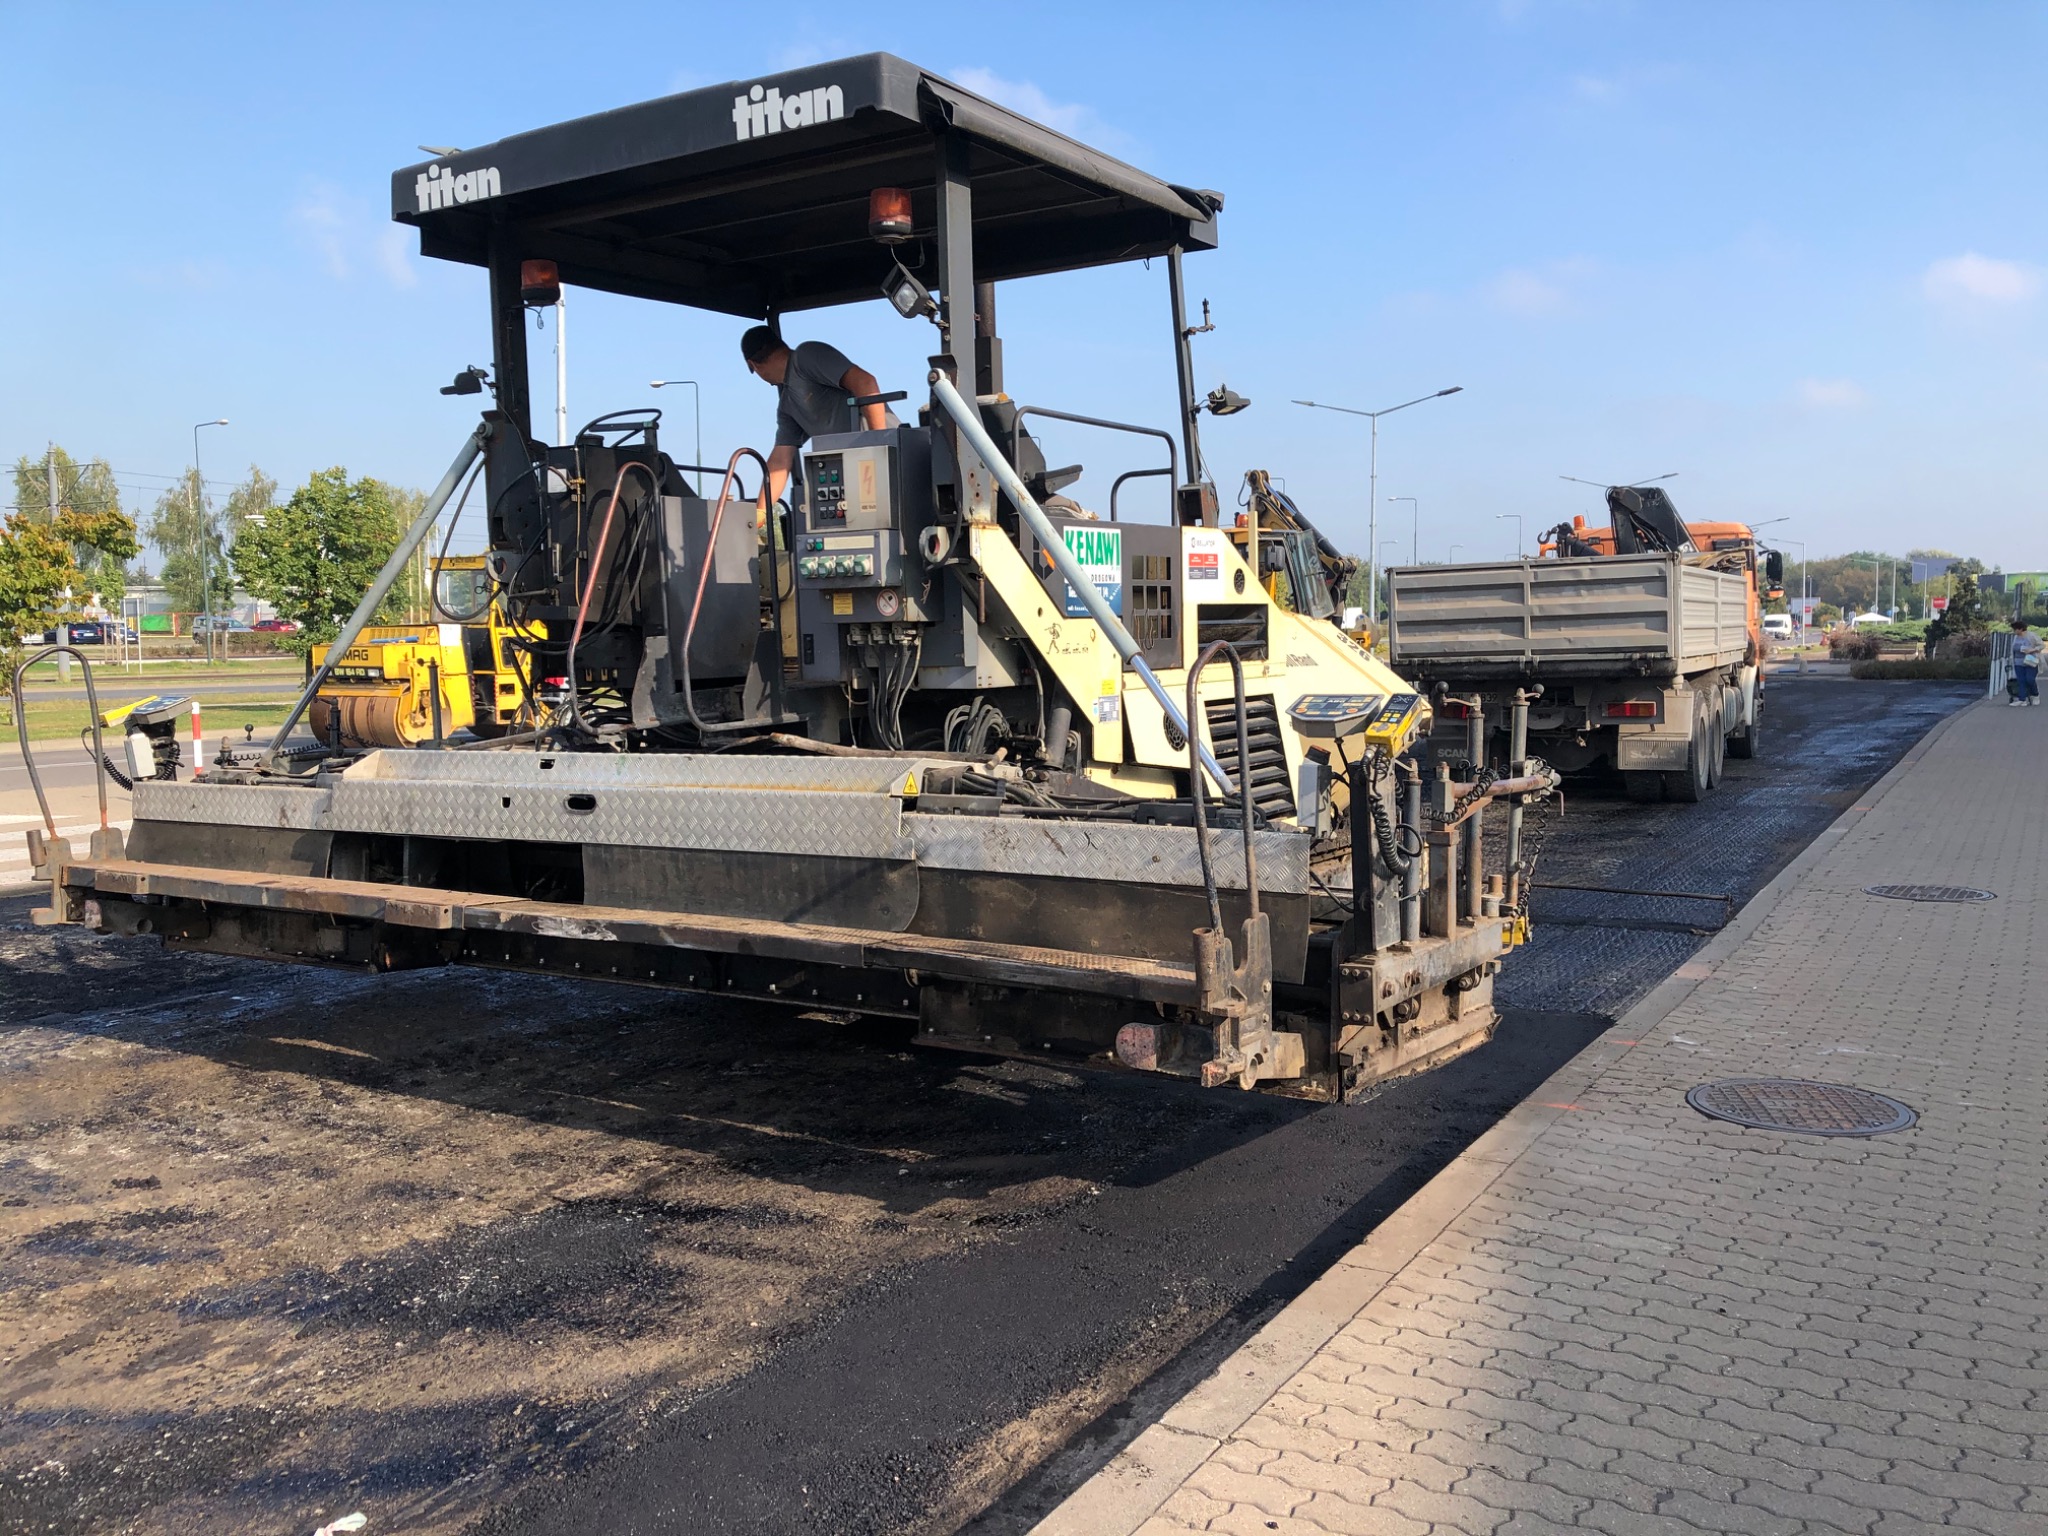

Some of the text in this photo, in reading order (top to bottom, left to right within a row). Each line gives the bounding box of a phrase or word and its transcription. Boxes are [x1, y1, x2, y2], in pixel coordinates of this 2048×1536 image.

[732, 84, 844, 141] titan
[415, 164, 501, 212] titan
[1065, 530, 1120, 566] KENAWI
[343, 649, 368, 660] MAG
[1437, 748, 1468, 758] SCAN
